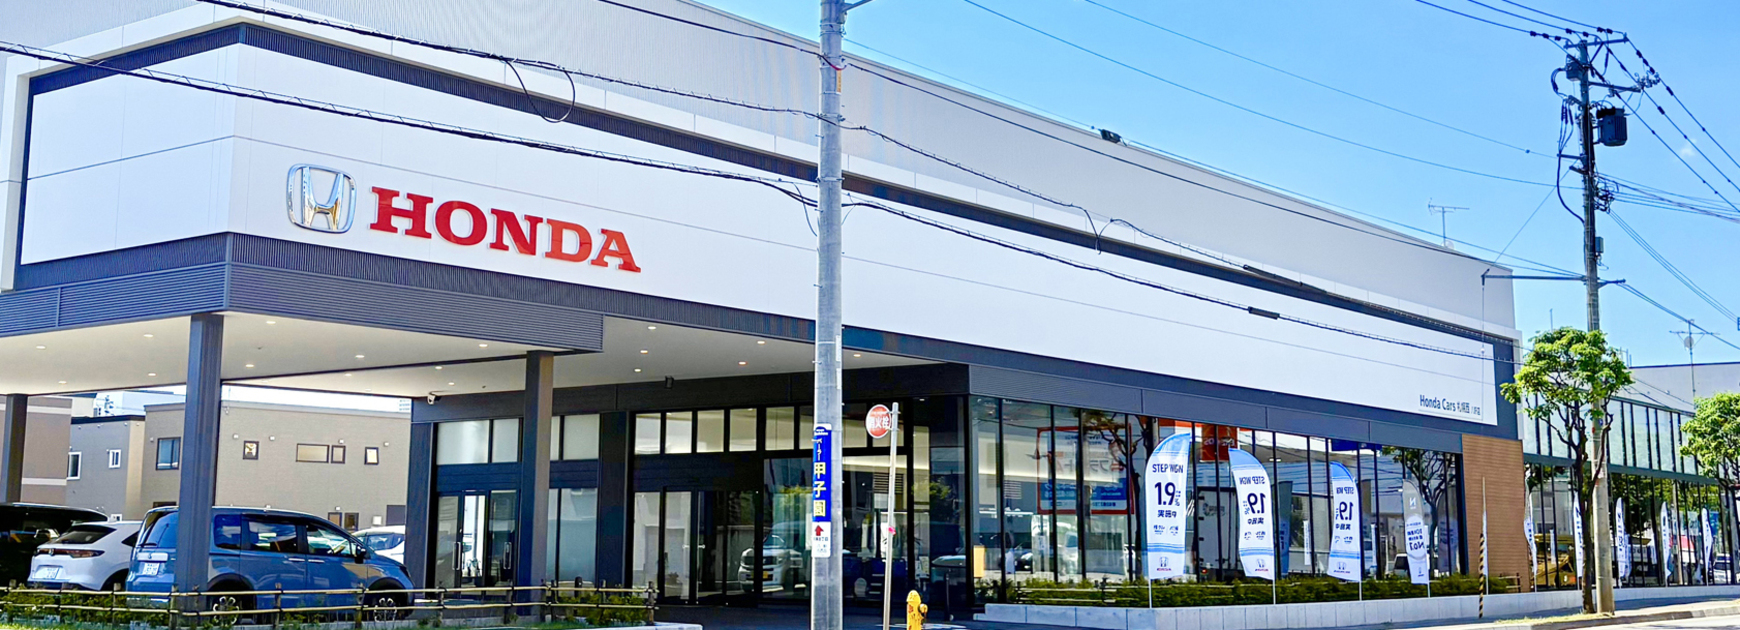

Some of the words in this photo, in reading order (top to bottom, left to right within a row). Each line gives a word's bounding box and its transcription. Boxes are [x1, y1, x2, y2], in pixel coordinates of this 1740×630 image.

[369, 186, 641, 273] HONDA
[1419, 394, 1441, 409] Honda
[1441, 398, 1456, 412] Cars
[1152, 464, 1168, 473] STEP
[813, 462, 826, 517] 甲子園
